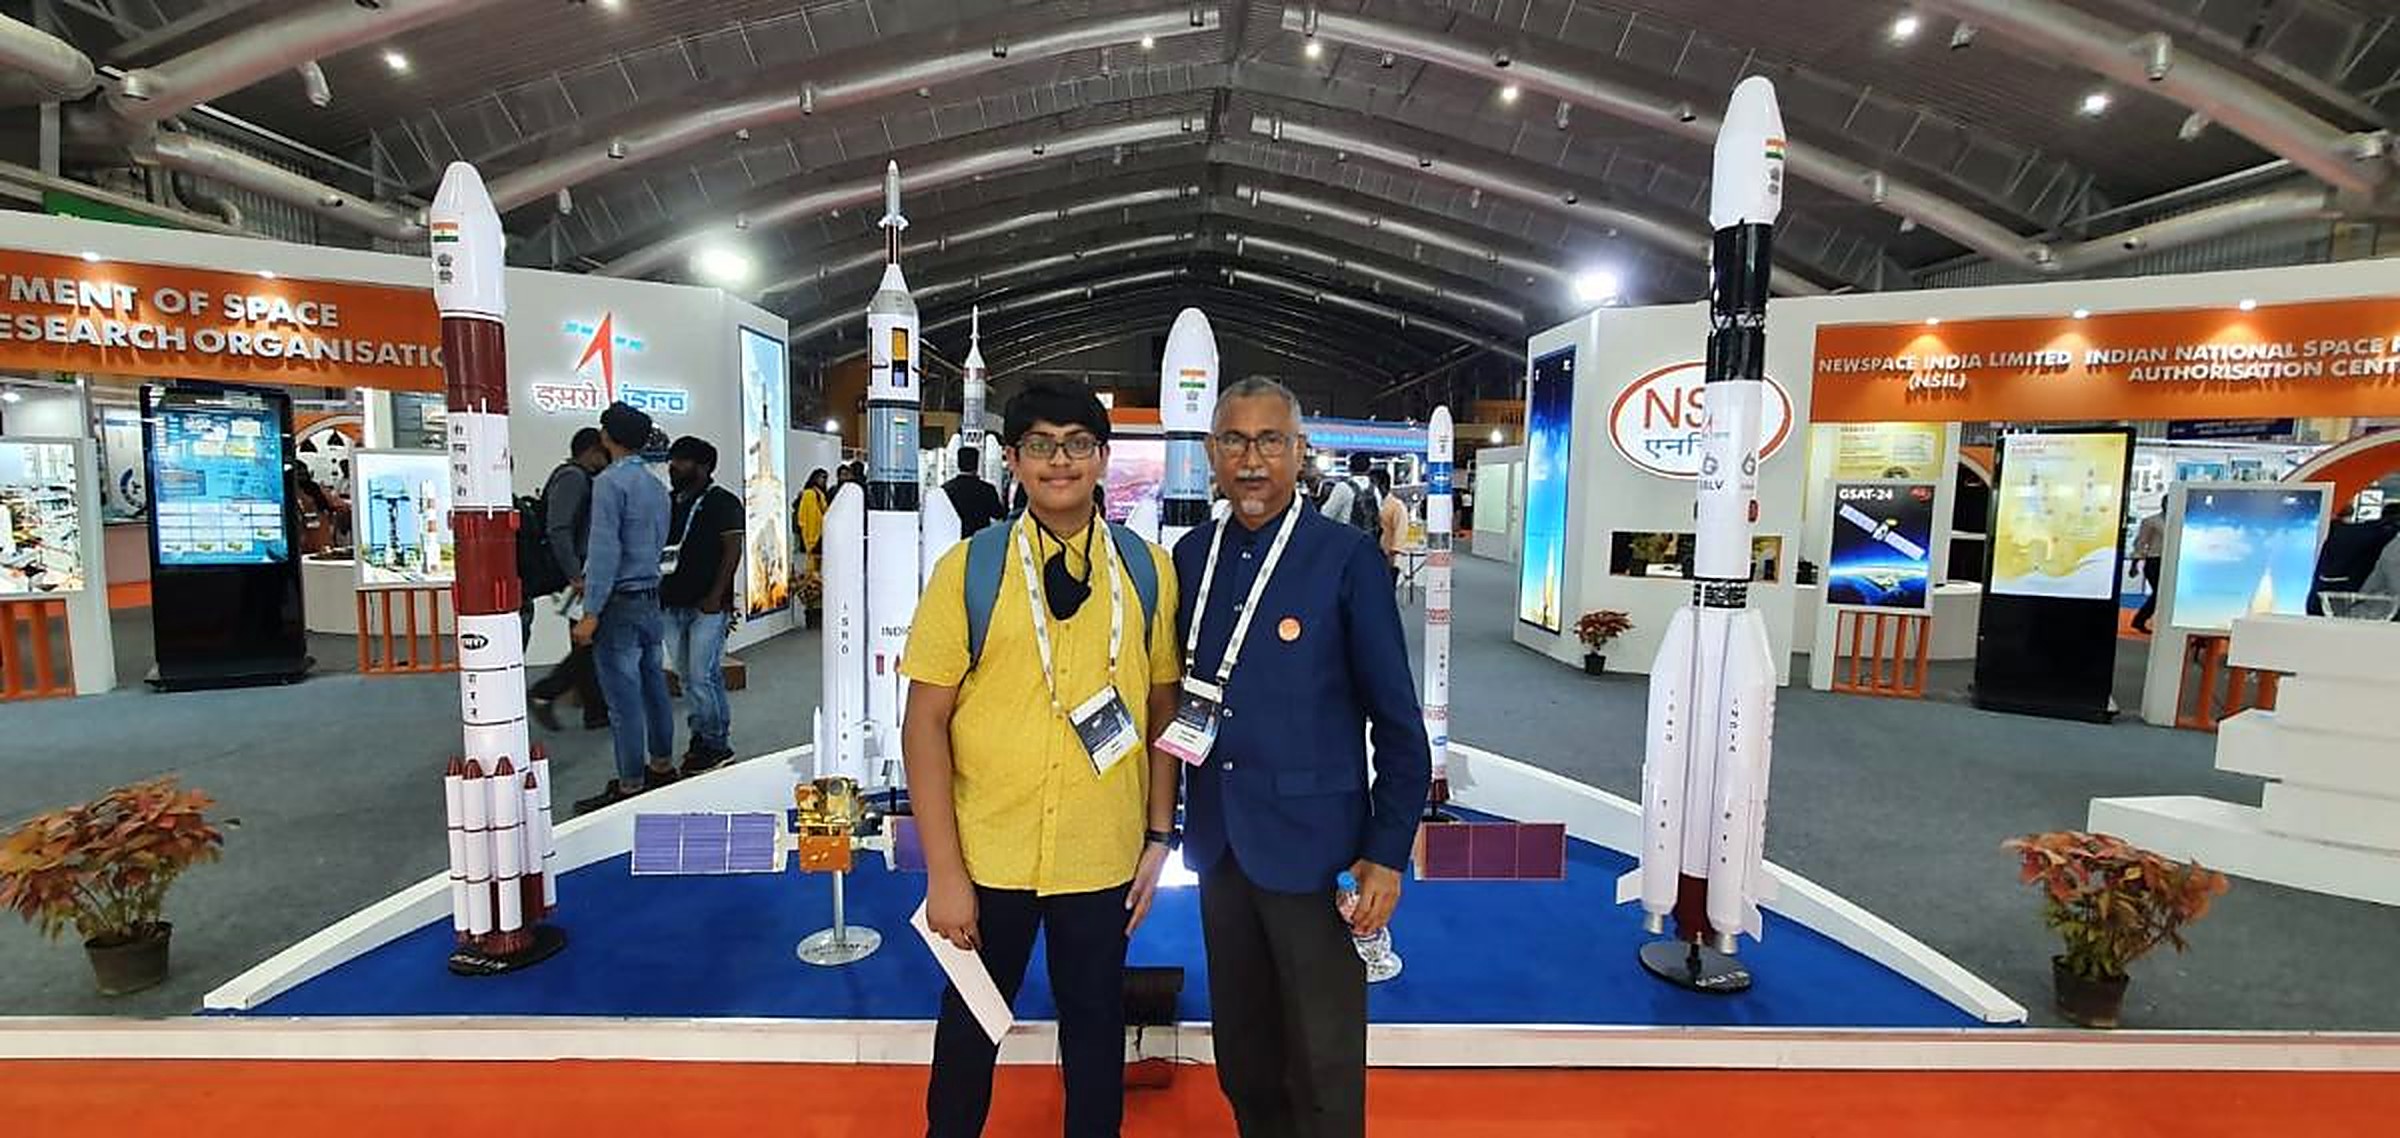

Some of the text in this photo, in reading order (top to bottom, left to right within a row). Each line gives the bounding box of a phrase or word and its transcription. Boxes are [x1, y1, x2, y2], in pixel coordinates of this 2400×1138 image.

[0, 274, 339, 327] MENT OF SPACE
[1819, 350, 2073, 373] NEWSPACE INDIA LIMITED
[2085, 346, 2168, 364] INDIAN
[2175, 341, 2298, 362] NATIONAL
[2303, 337, 2385, 357] SPACE
[1908, 373, 1967, 391] (NSIL)
[2129, 360, 2323, 382] AUTHORISATION
[535, 382, 597, 414] इसरो
[621, 384, 686, 411] isro
[1644, 387, 1705, 429] NS
[1839, 488, 1894, 500] GSAT-24
